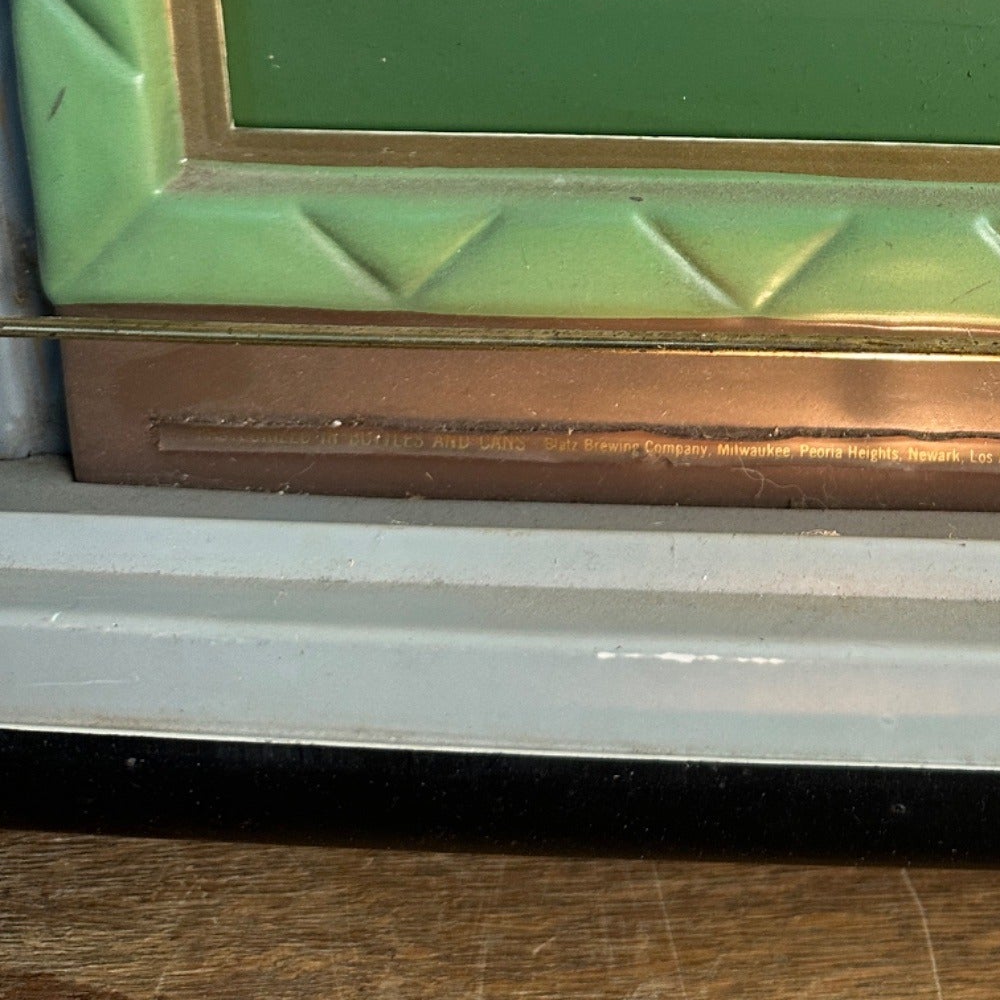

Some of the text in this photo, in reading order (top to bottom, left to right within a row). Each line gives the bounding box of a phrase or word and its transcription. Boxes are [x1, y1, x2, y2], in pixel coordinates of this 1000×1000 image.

[432, 435, 469, 450] AND
[479, 436, 526, 451] CANS
[584, 438, 640, 456] Brewing
[644, 439, 713, 457] Company,
[717, 442, 795, 460] Milwaukee,
[800, 444, 843, 460] Peoria
[848, 445, 903, 463] Heights,
[908, 446, 966, 466] Newark,
[970, 449, 993, 464] Los
